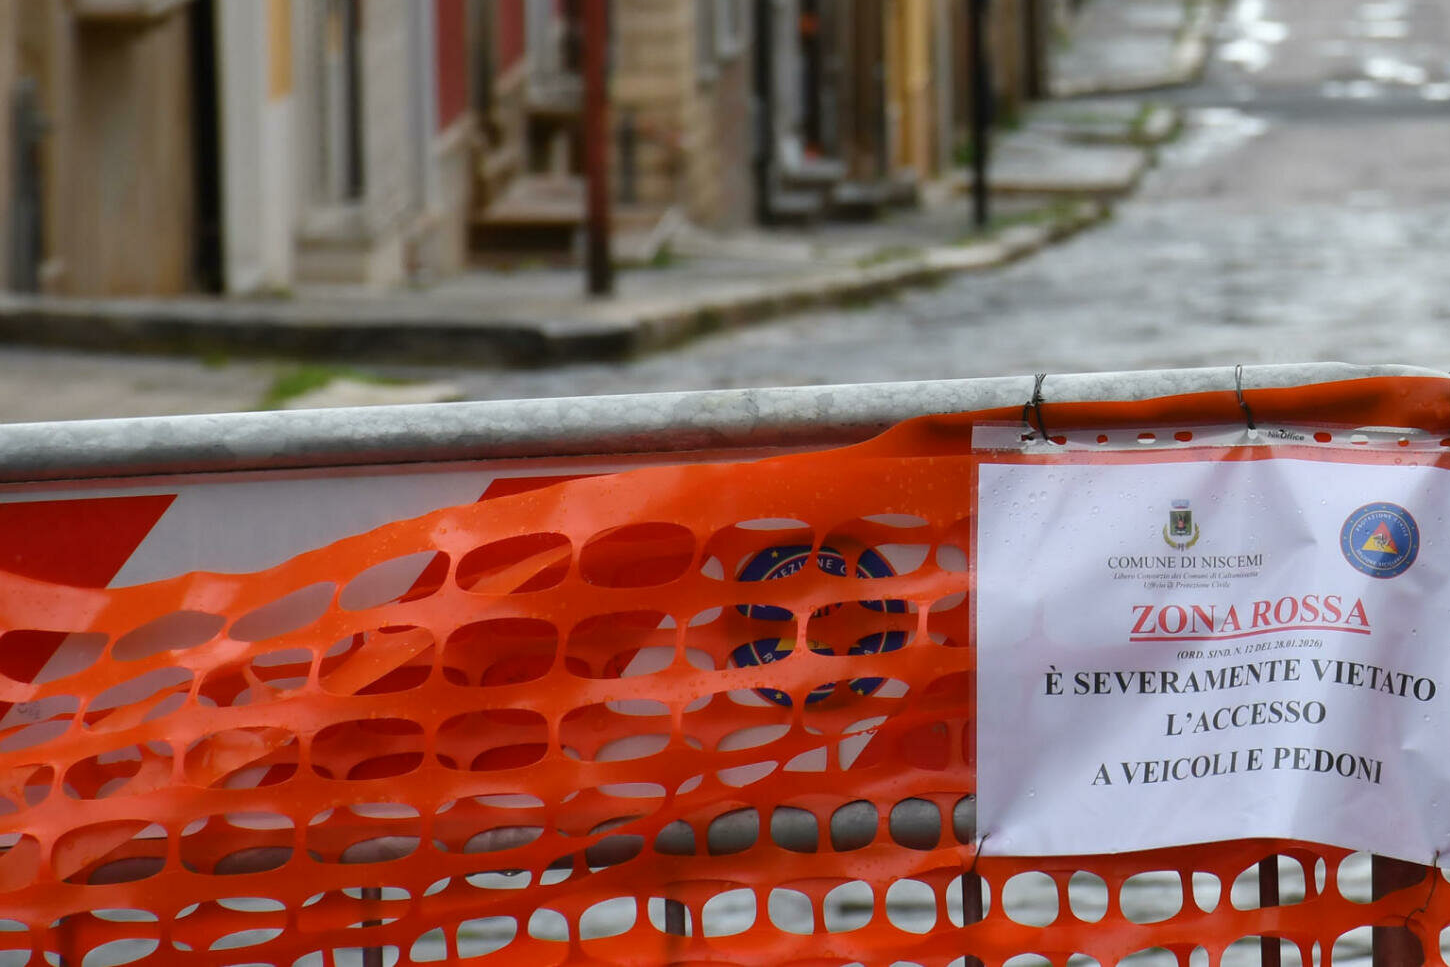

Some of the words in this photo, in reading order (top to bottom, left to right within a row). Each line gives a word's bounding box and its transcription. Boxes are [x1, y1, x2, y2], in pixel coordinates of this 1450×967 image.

[1108, 556, 1176, 569] COMUNE
[1181, 556, 1196, 569] DI
[1201, 554, 1263, 568] NISCEMI
[1131, 605, 1242, 635] ZONA
[1250, 594, 1370, 629] ROSSA
[1244, 644, 1254, 654] 12
[1255, 642, 1272, 652] DEL
[1045, 665, 1064, 695] È
[1073, 659, 1301, 695] SEVERAMENTE
[1310, 659, 1437, 702] VIETATO
[1166, 700, 1327, 736] L’ACCESSO
[1091, 763, 1112, 785] A
[1121, 751, 1239, 784] VEICOLI
[1246, 748, 1263, 772] E
[1272, 747, 1384, 785] PEDONI
